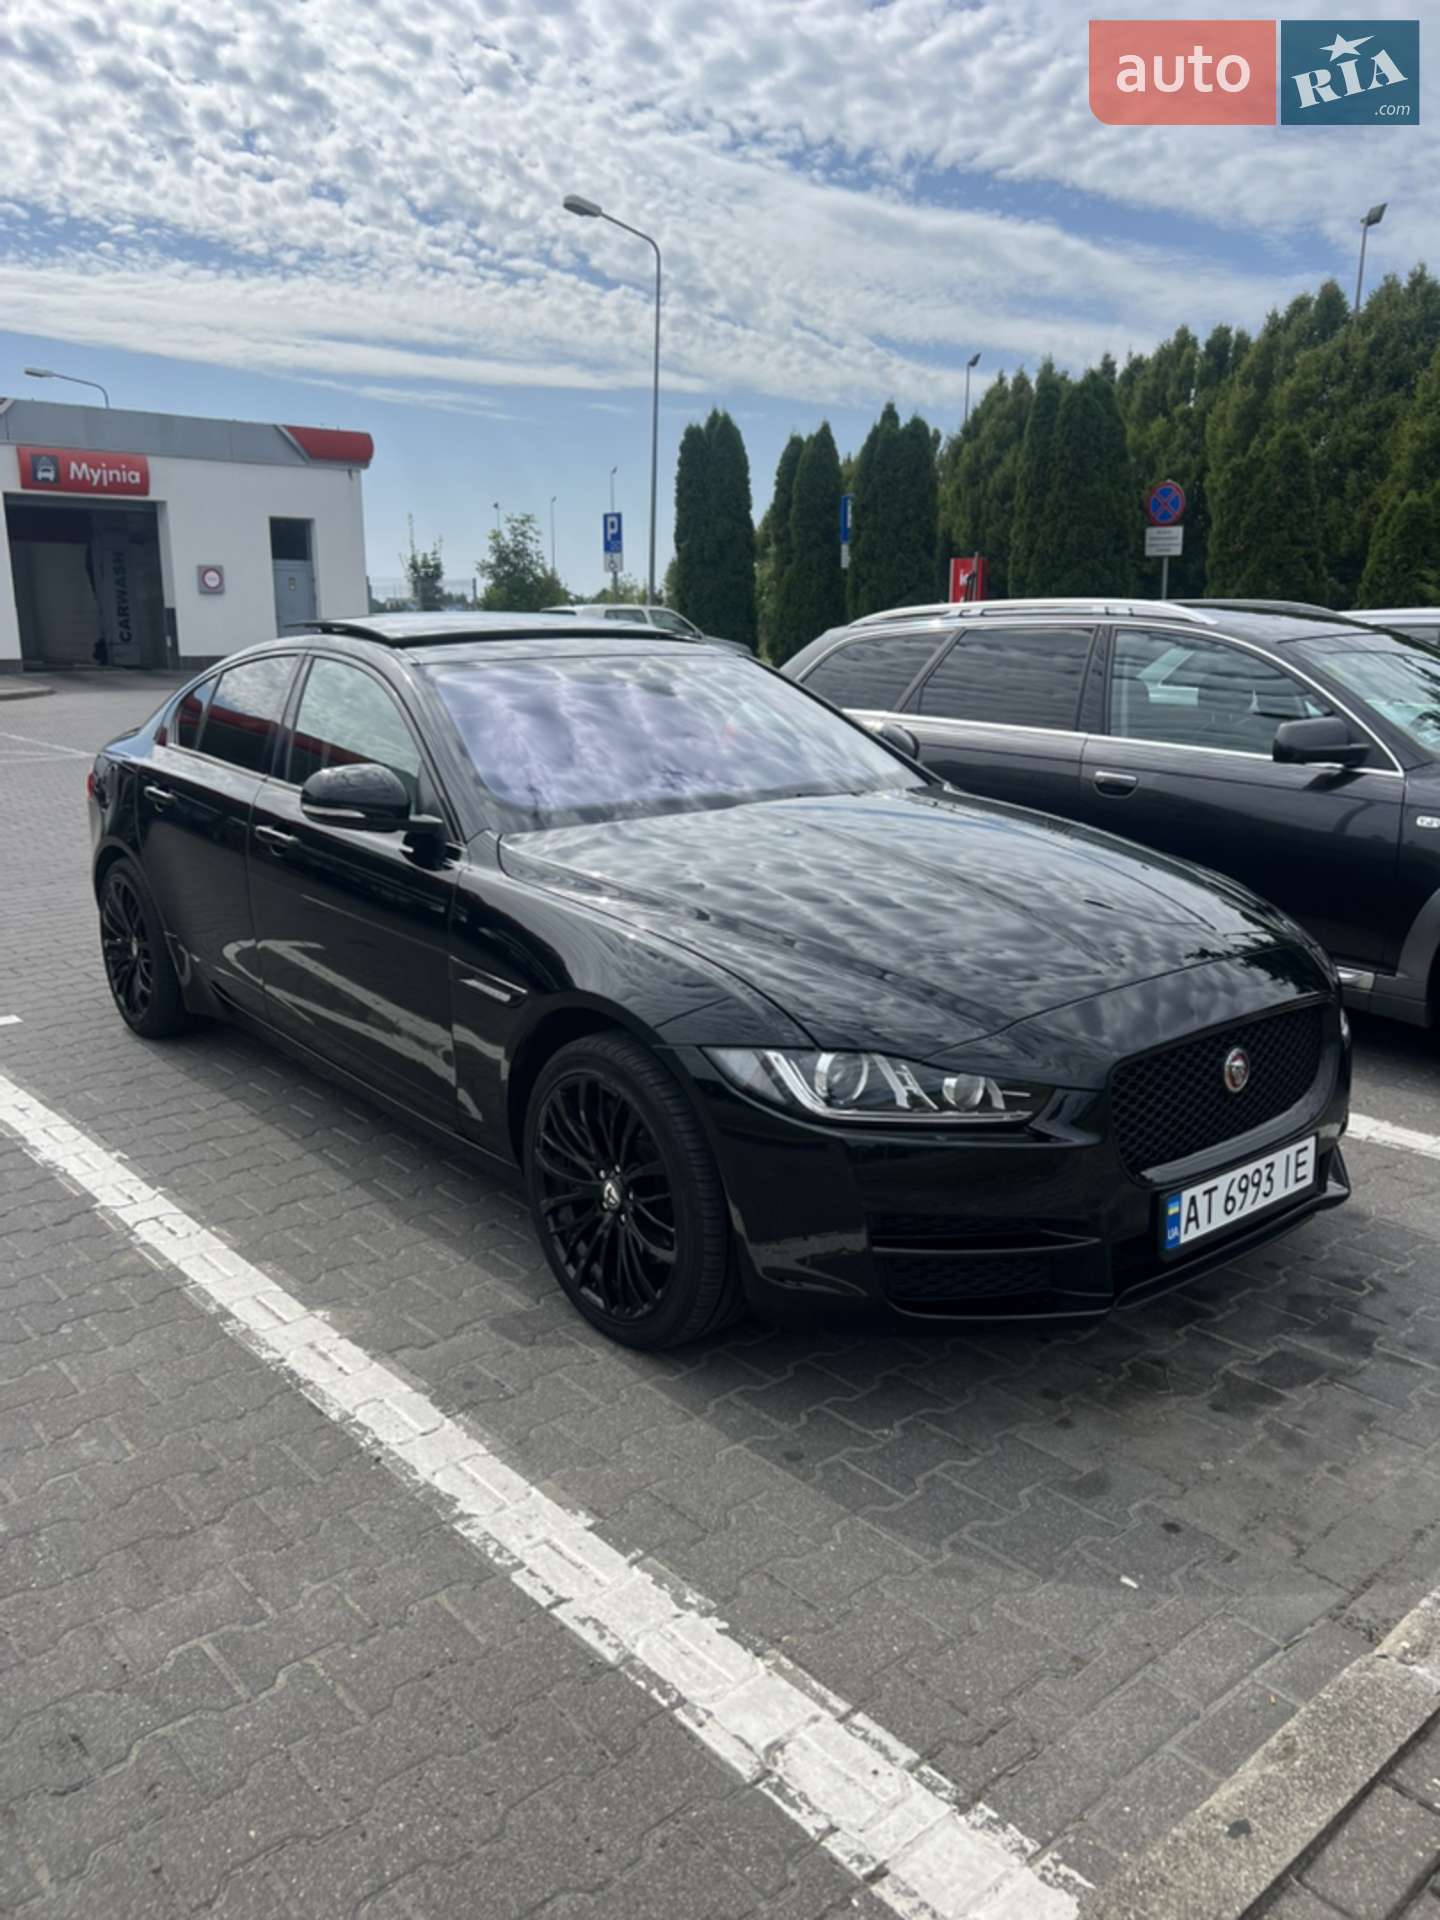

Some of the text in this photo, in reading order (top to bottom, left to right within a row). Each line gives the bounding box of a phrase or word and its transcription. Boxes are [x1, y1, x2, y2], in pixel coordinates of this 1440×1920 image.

[70, 461, 141, 487] Myjnia
[607, 515, 619, 541] P
[112, 551, 132, 643] CARWASH
[1183, 1146, 1309, 1235] AT 6993 IE
[1167, 1226, 1180, 1240] UA
